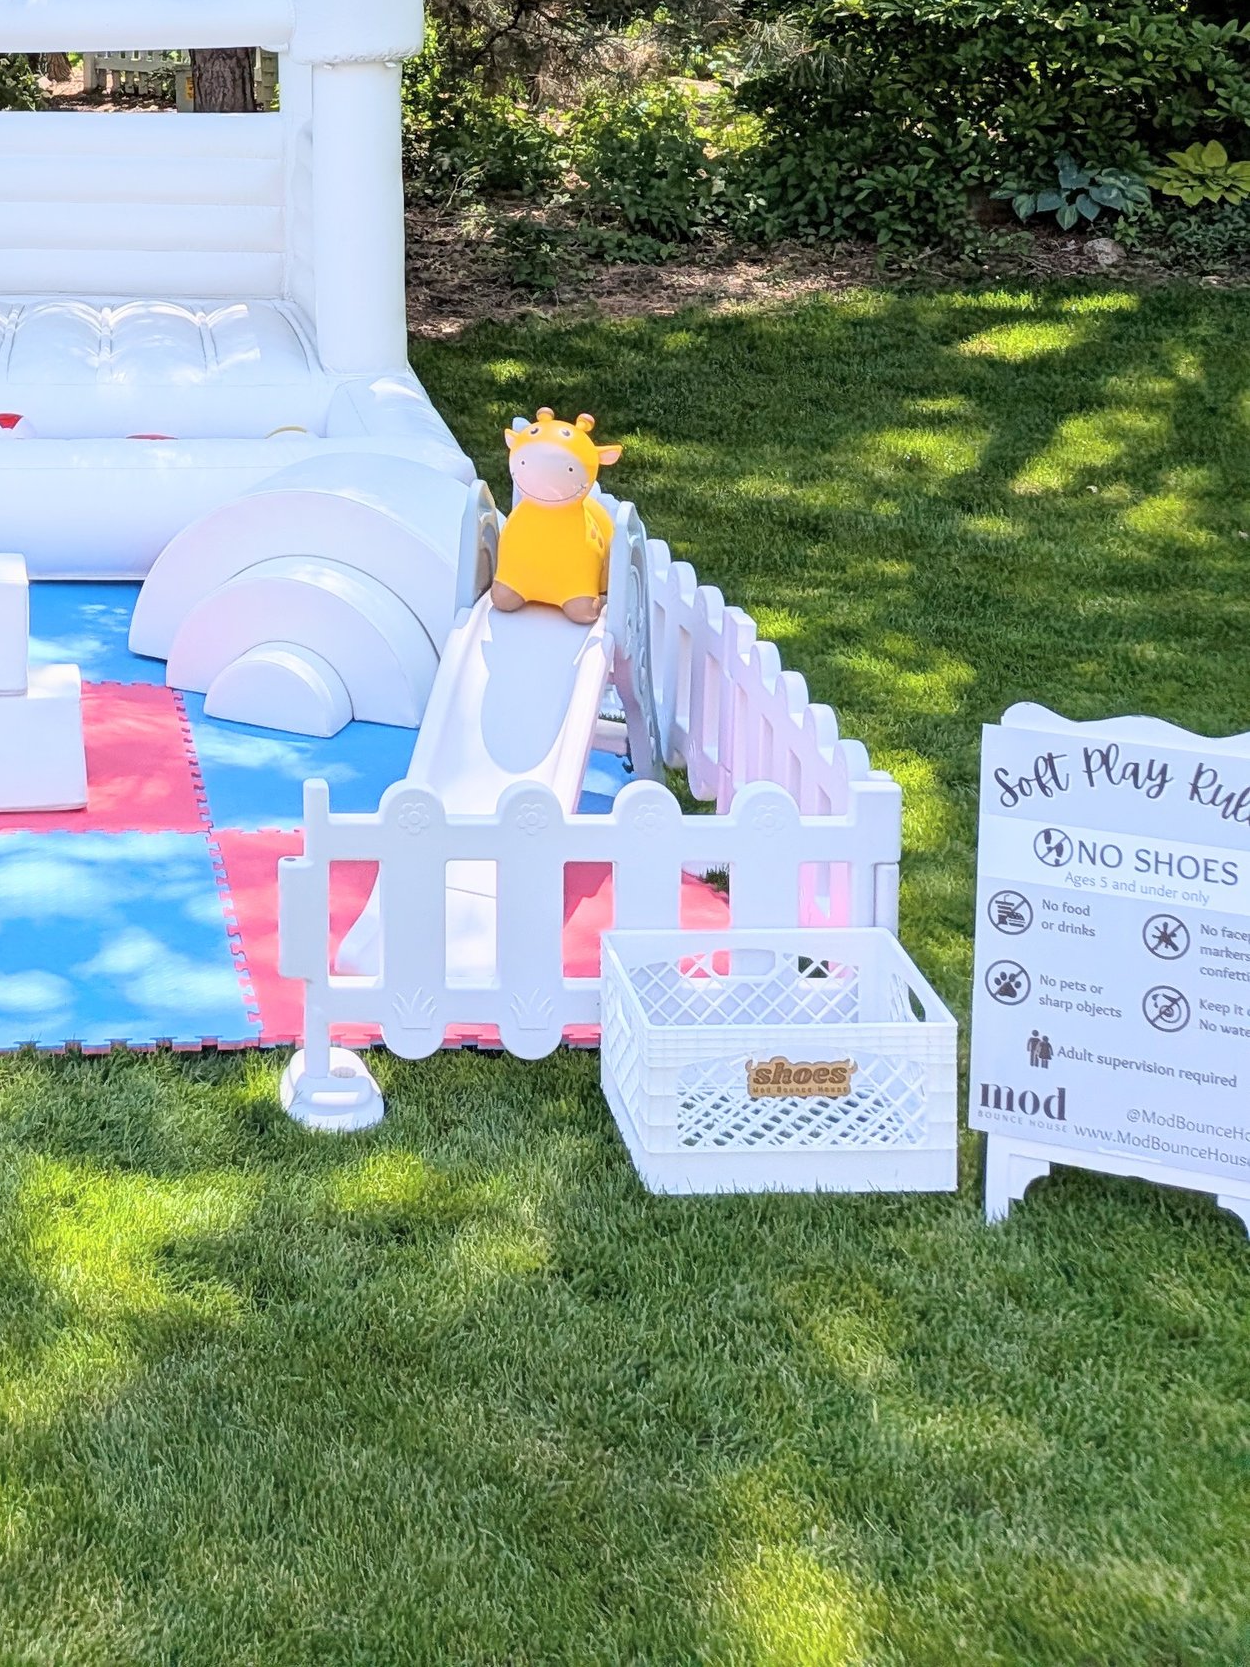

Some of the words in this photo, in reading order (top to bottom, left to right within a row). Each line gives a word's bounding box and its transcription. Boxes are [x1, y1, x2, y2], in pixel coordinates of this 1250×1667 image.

[994, 752, 1069, 807] Soft
[1082, 743, 1173, 799] Play
[1078, 840, 1123, 868] NO
[1134, 849, 1239, 886] SHOES
[1064, 871, 1096, 888] Ages
[1100, 877, 1108, 888] 5
[1112, 880, 1136, 893] and
[1140, 885, 1177, 899] under
[1181, 890, 1210, 907] only
[1042, 899, 1059, 911] No
[1062, 902, 1091, 916] food
[1041, 921, 1054, 930] or
[1057, 921, 1096, 937] drinks
[1200, 923, 1218, 936] No
[1040, 974, 1056, 987] No
[1060, 980, 1087, 992] pets
[1090, 985, 1104, 994] or
[1039, 994, 1073, 1013] sharp
[1076, 1000, 1122, 1018] objects
[1199, 998, 1230, 1016] Keep
[1234, 1004, 1244, 1016] it
[1199, 1018, 1217, 1032] No
[753, 1062, 848, 1085] shoes
[1057, 1045, 1094, 1063] Adult
[1097, 1054, 1175, 1077] supervision
[1178, 1067, 1237, 1088] required
[980, 1083, 1067, 1121] mod
[977, 1110, 1023, 1125] BOUNCE
[1029, 1119, 1067, 1133] HOUSE
